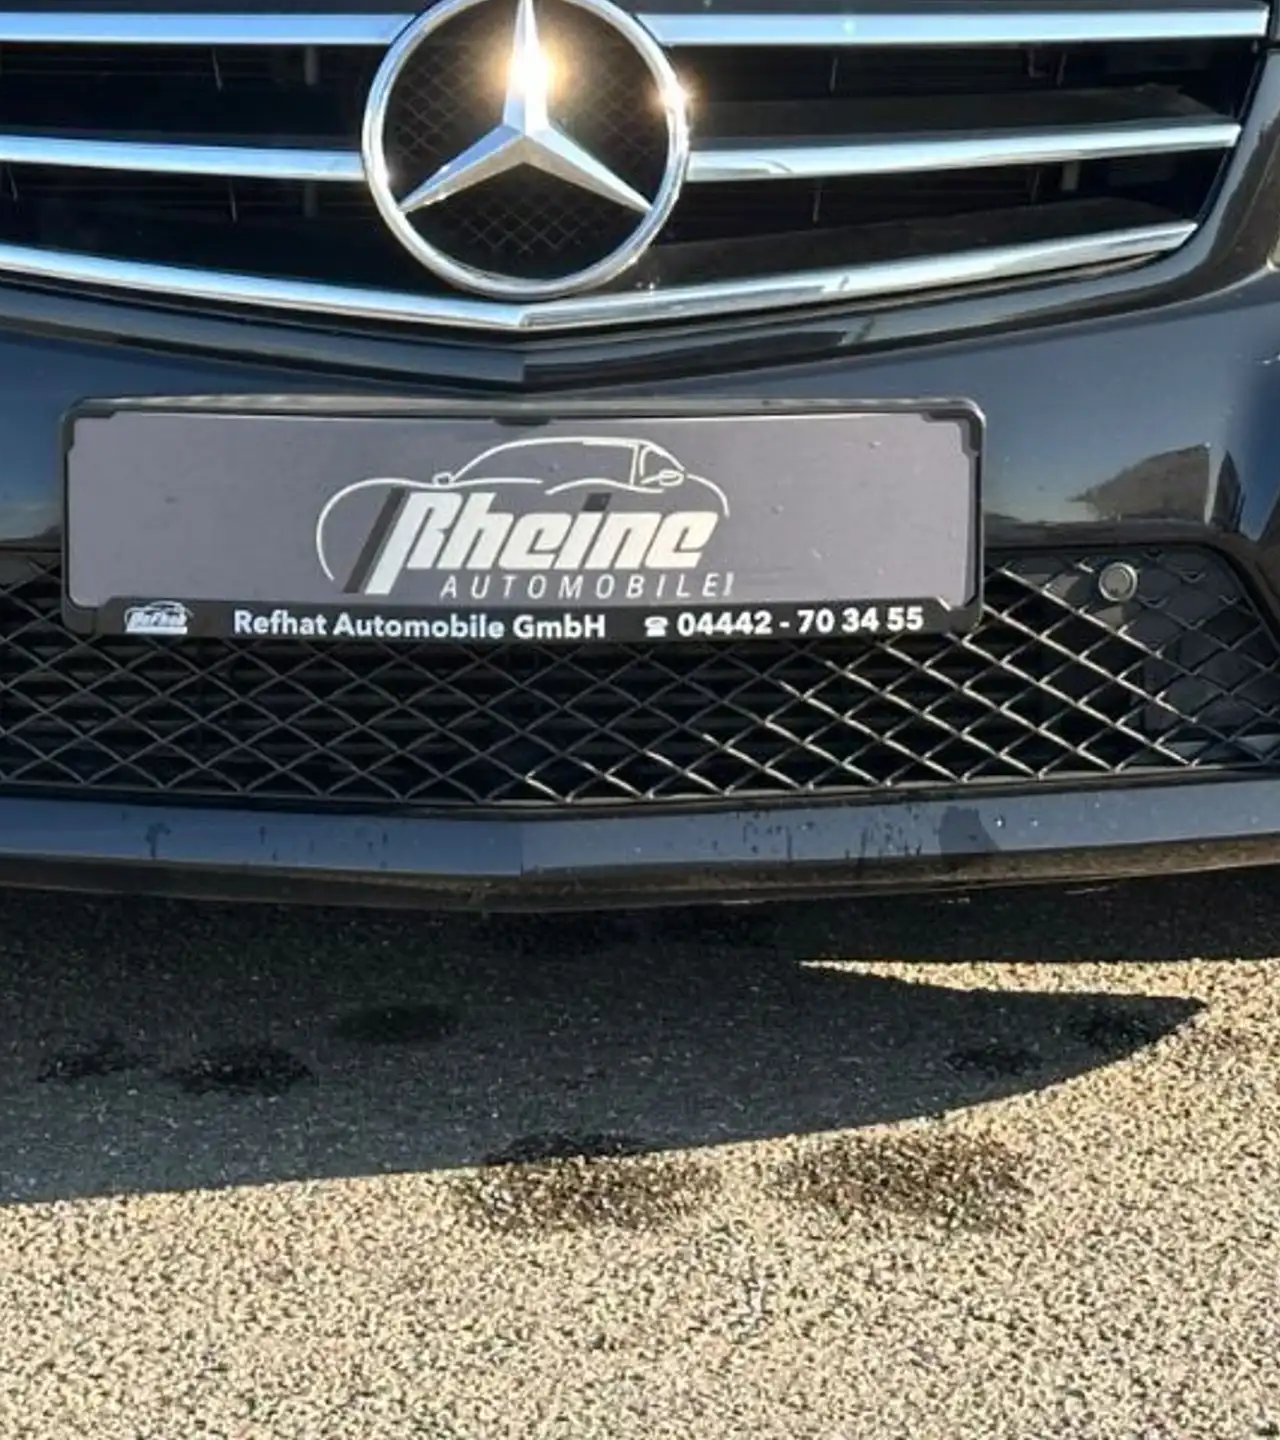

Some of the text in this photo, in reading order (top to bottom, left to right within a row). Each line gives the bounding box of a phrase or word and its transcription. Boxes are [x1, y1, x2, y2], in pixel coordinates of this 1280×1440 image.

[363, 490, 720, 596] Rheine
[233, 608, 328, 637] Refhat
[332, 611, 506, 640] Automobile
[512, 612, 607, 640] GmbH
[676, 610, 773, 637] 04442
[797, 608, 835, 635] 70
[840, 607, 880, 634] 34
[886, 606, 924, 632] 55
